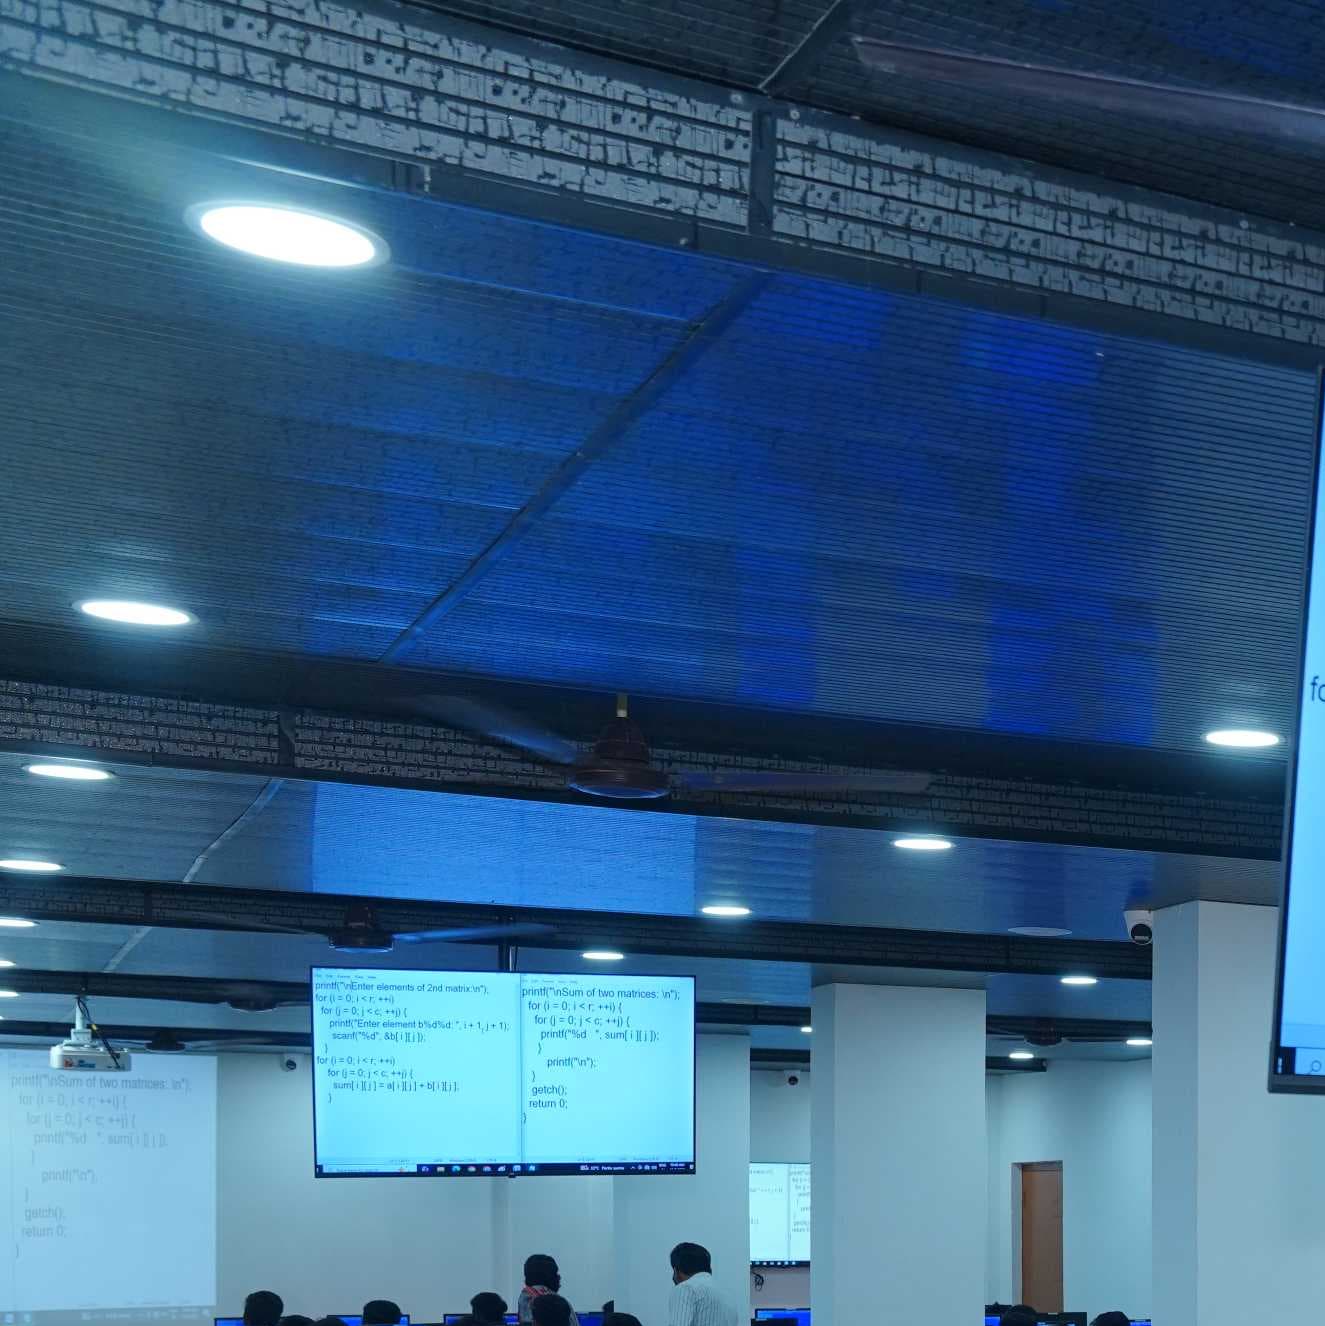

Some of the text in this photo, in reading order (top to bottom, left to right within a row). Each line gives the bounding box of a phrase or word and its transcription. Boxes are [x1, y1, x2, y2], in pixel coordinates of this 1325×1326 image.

[586, 988, 595, 998] of
[598, 988, 615, 998] two
[529, 1099, 557, 1108] return
